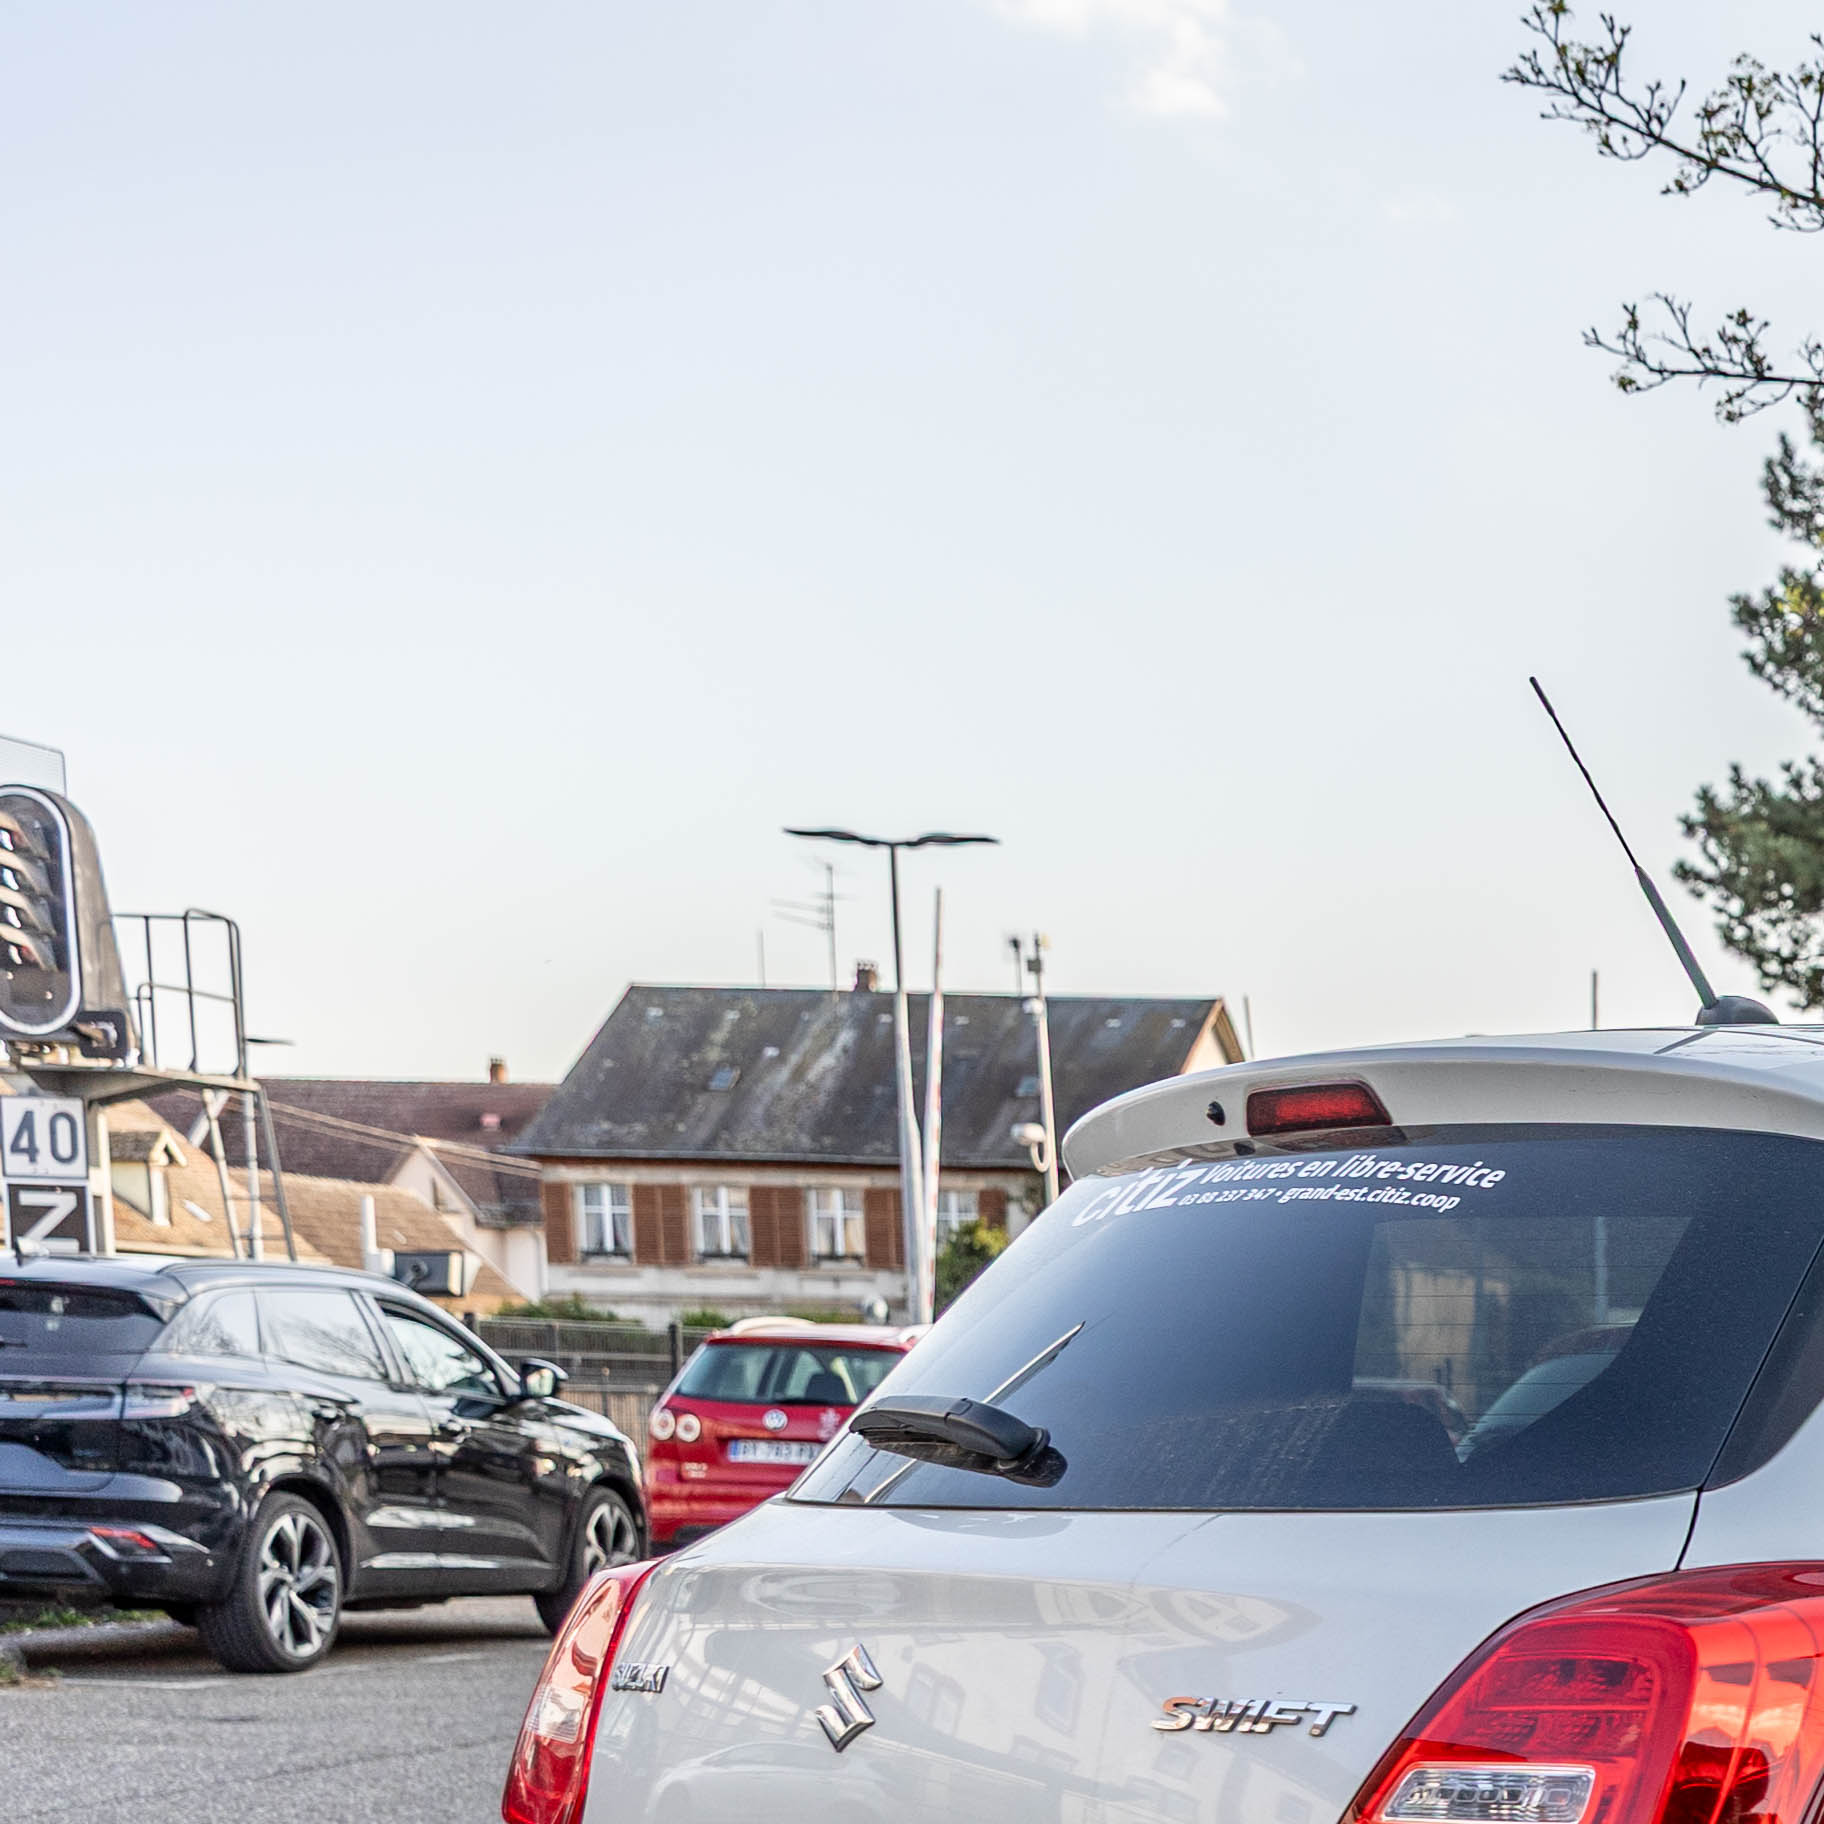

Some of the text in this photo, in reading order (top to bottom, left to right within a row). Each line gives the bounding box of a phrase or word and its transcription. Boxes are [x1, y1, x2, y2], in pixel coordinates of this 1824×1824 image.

[10, 1110, 78, 1163] 40
[1072, 1158, 1208, 1227] citiz
[1200, 1154, 1506, 1189] Voitures en libre-service
[1277, 1184, 1461, 1213] grand-est.citiz.coop
[1150, 1696, 1359, 1738] SWIFT
